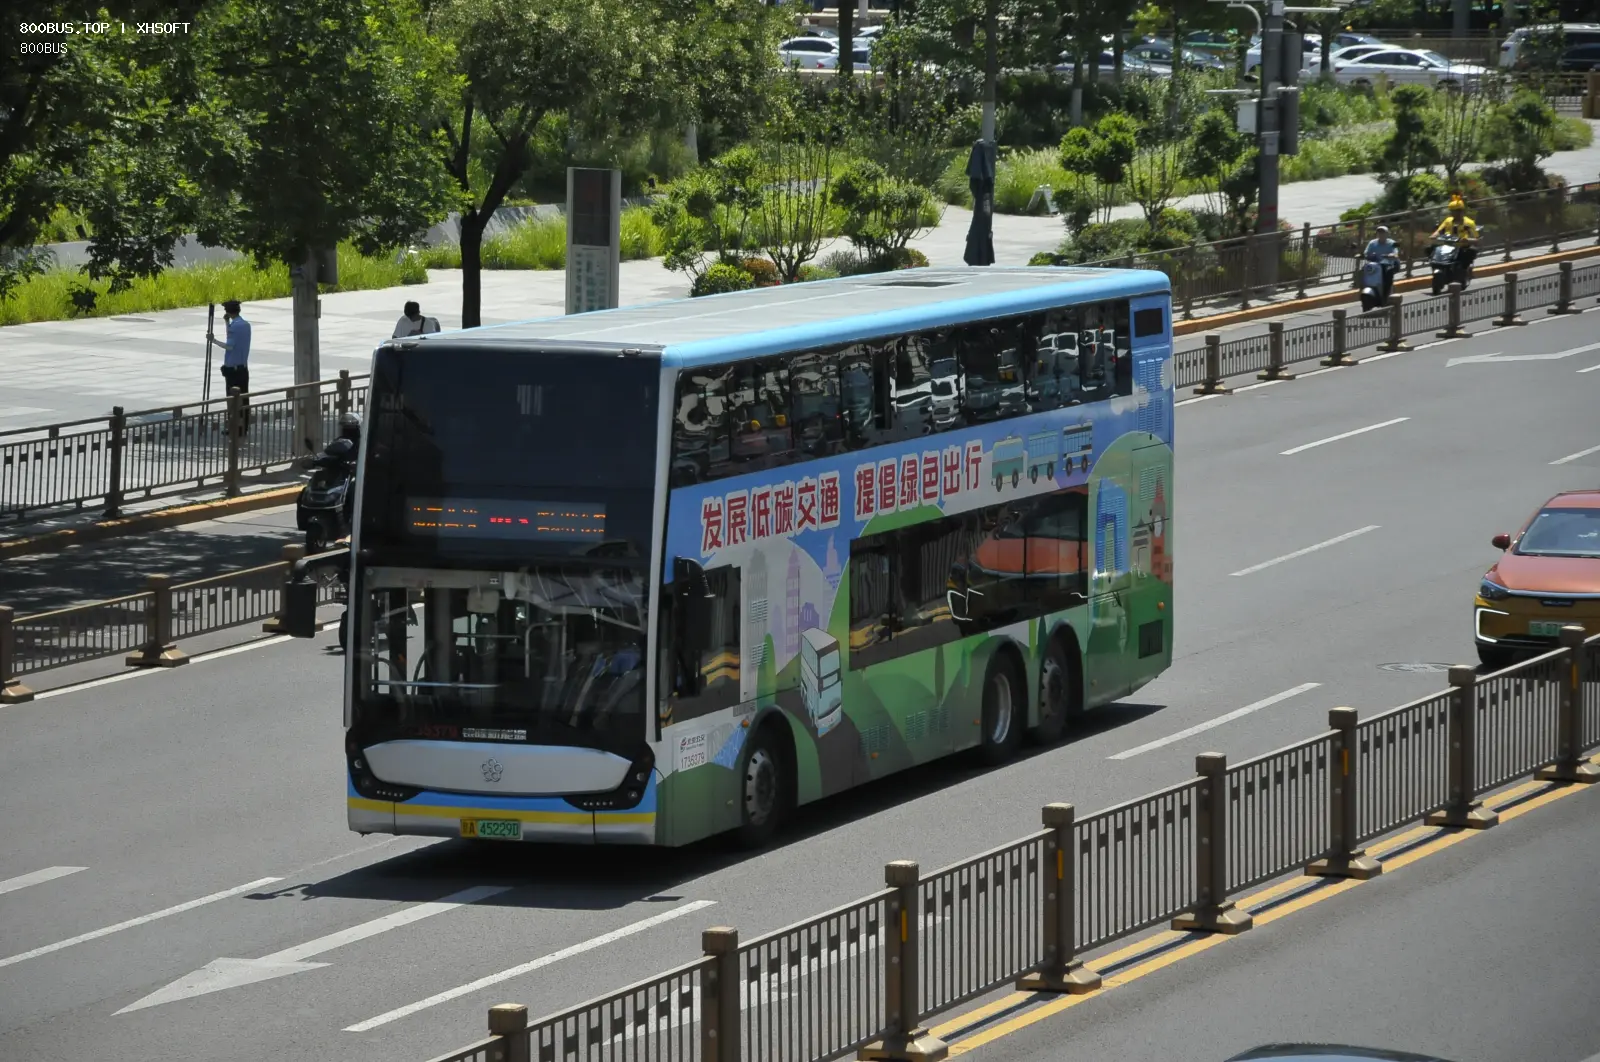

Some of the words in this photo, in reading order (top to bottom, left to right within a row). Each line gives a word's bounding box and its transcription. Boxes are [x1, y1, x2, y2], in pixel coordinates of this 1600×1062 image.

[701, 475, 839, 553] 发展低碳交通
[855, 444, 983, 516] 提倡绿色出行
